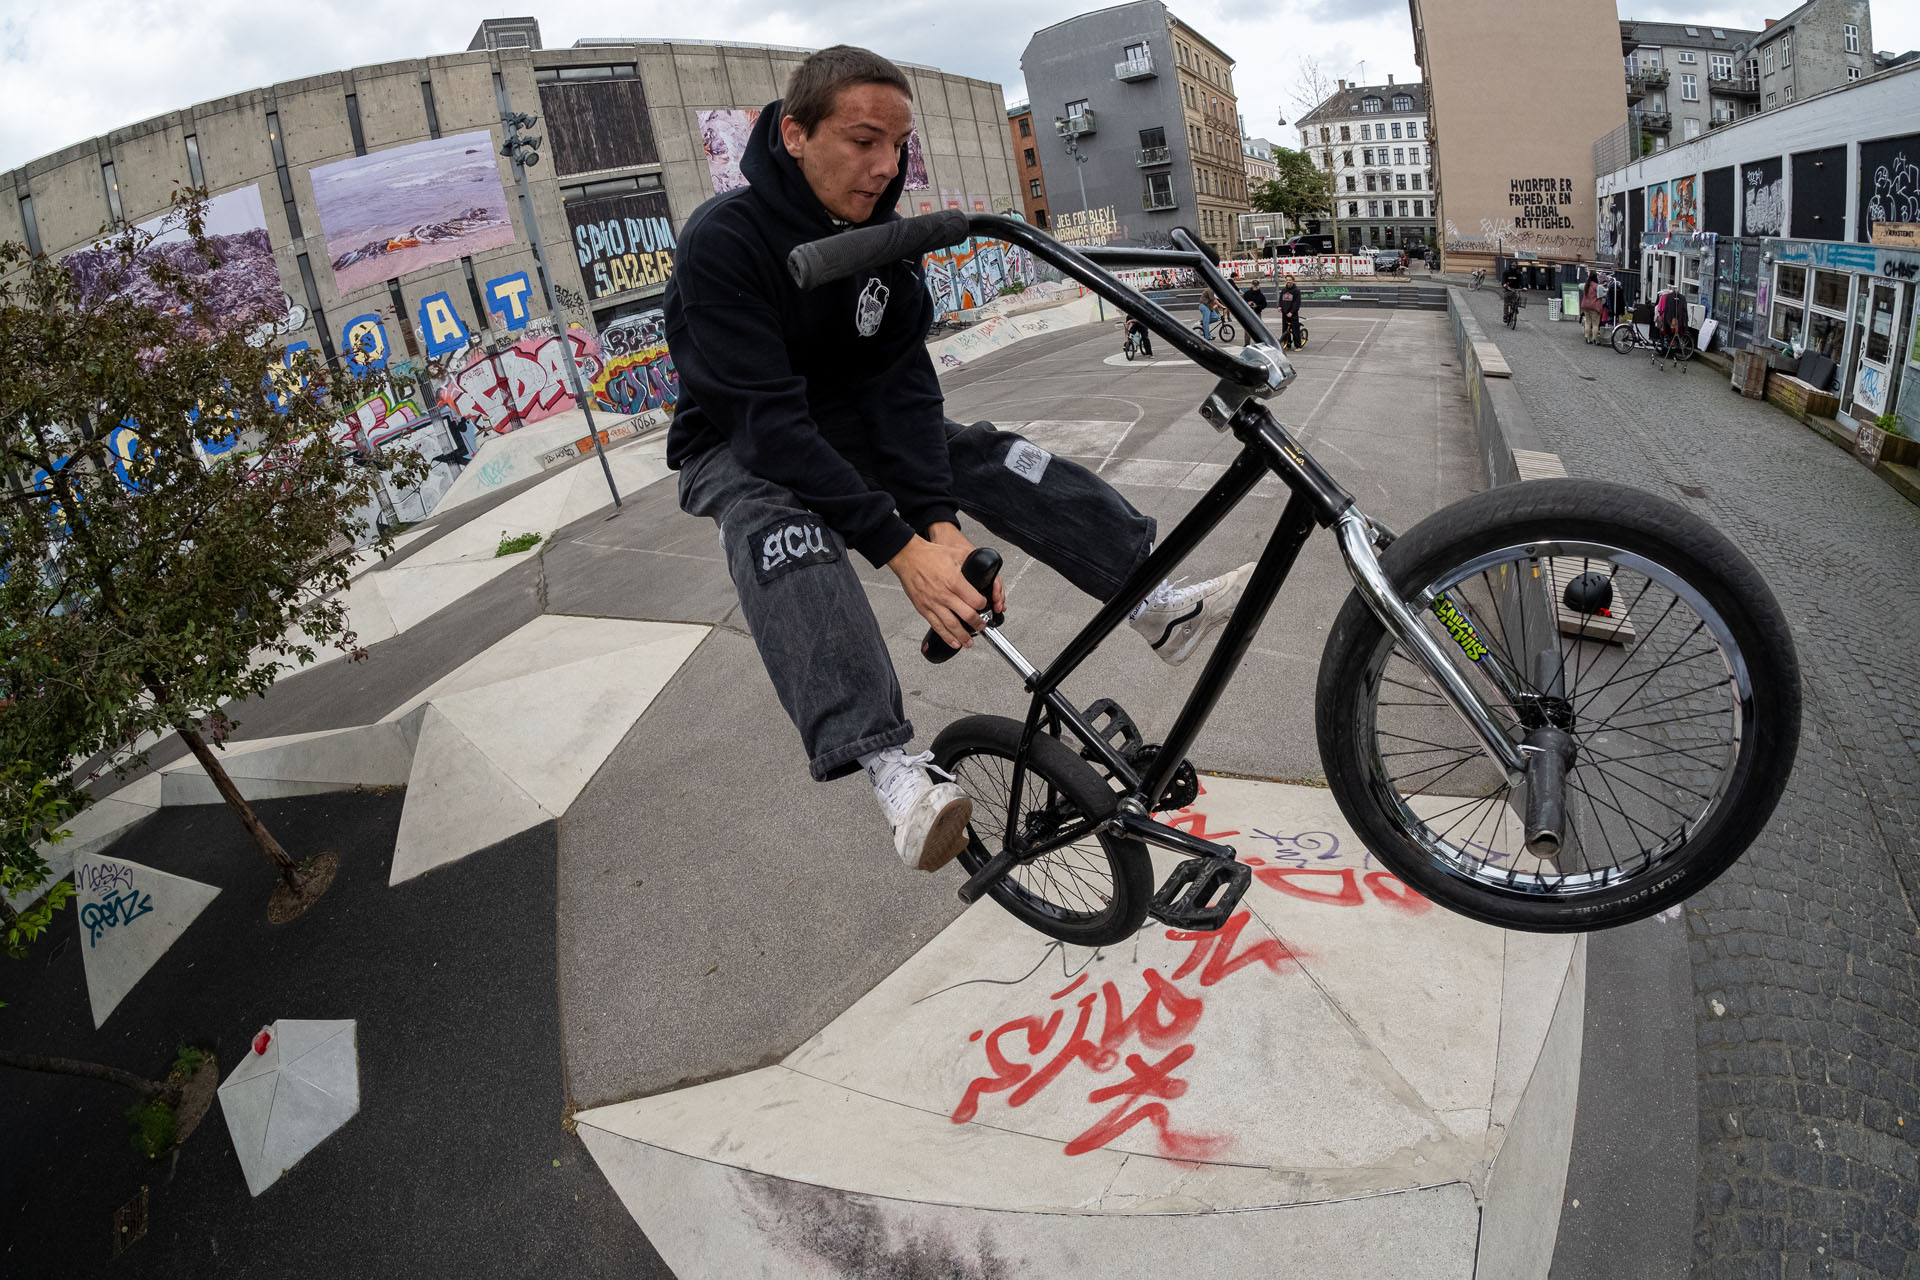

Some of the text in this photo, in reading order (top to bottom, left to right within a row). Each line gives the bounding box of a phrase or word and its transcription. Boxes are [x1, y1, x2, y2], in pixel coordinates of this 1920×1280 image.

[1511, 178, 1573, 192] HVORFOR ER
[1559, 192, 1571, 205] EN
[1524, 205, 1559, 218] GLOBAL
[624, 216, 677, 254] PUM
